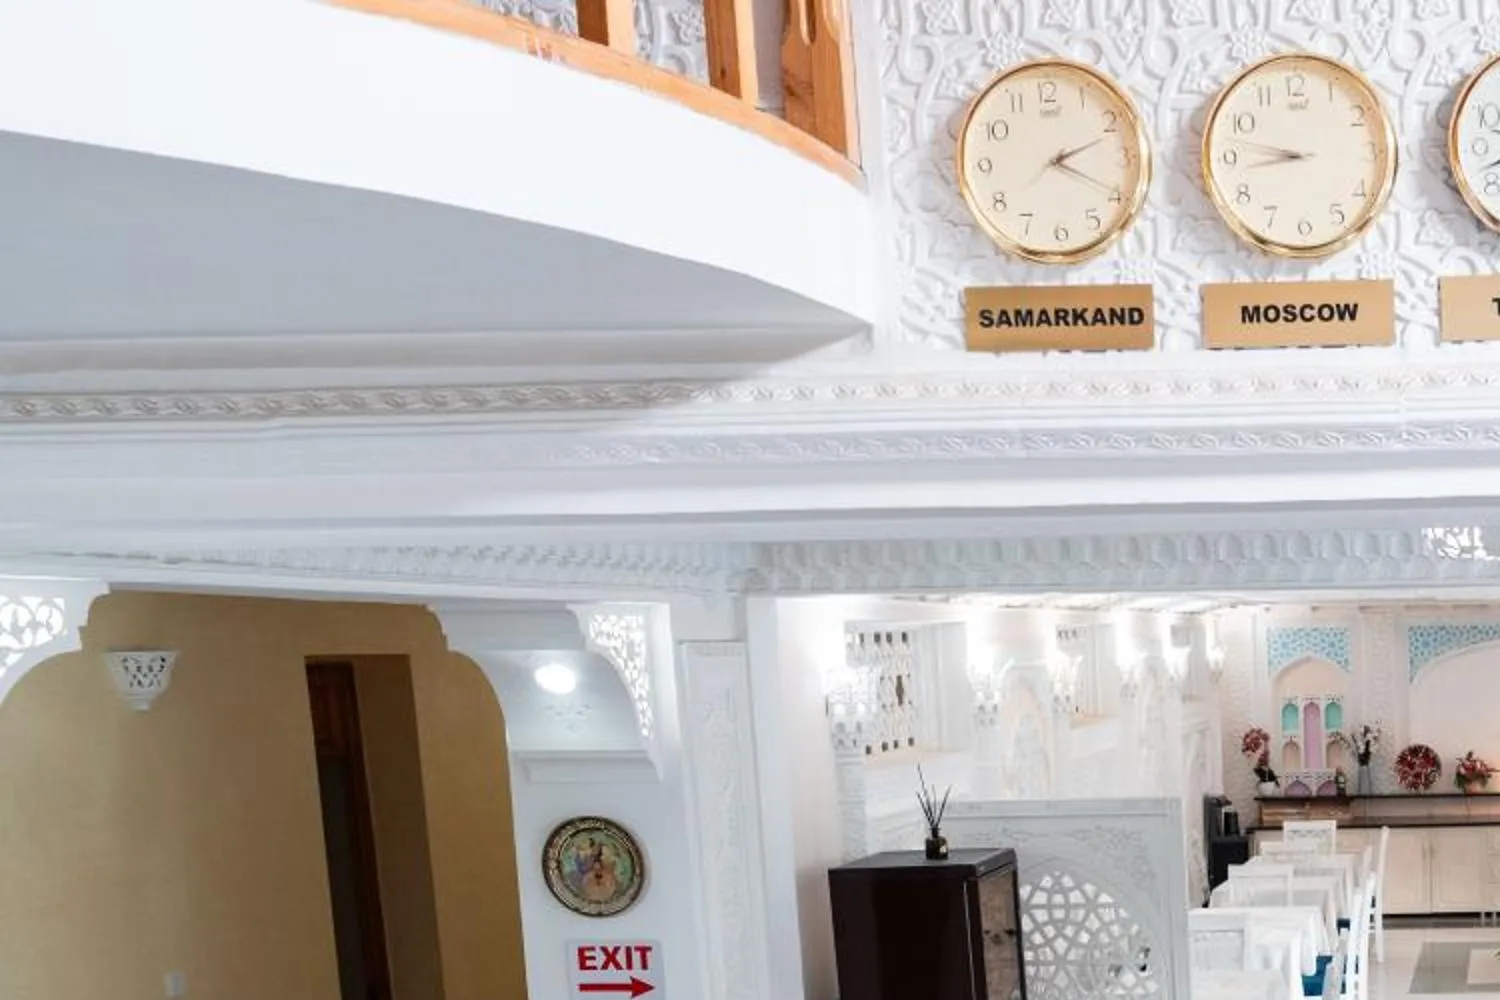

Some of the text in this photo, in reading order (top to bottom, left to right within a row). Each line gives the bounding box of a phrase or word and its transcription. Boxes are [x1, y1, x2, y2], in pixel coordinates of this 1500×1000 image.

[1037, 81, 1057, 104] 12
[1258, 84, 1271, 107] 11
[1285, 74, 1306, 97] 12
[1328, 80, 1333, 103] 1
[1010, 92, 1024, 113] 11
[1078, 86, 1085, 110] 1
[1103, 110, 1118, 133] 2
[1233, 111, 1256, 135] 10
[1349, 104, 1365, 127] 2
[1477, 102, 1500, 129] 10
[986, 118, 1009, 141] 10
[1223, 148, 1237, 166] 9
[1471, 137, 1489, 157] 9
[977, 157, 993, 175] 9
[1107, 185, 1121, 205] 4
[1236, 183, 1251, 205] 8
[1352, 179, 1367, 199] 4
[1483, 171, 1500, 196] 8
[992, 191, 1007, 213] 8
[1019, 212, 1033, 236] 7
[1085, 208, 1101, 230] 5
[1263, 205, 1278, 229] 7
[1329, 203, 1345, 225] 5
[1054, 223, 1069, 242] 6
[1297, 218, 1313, 237] 6
[979, 305, 1145, 329] SAMARKAND
[1240, 302, 1359, 324] MOSCOW
[577, 944, 653, 971] EXIT
